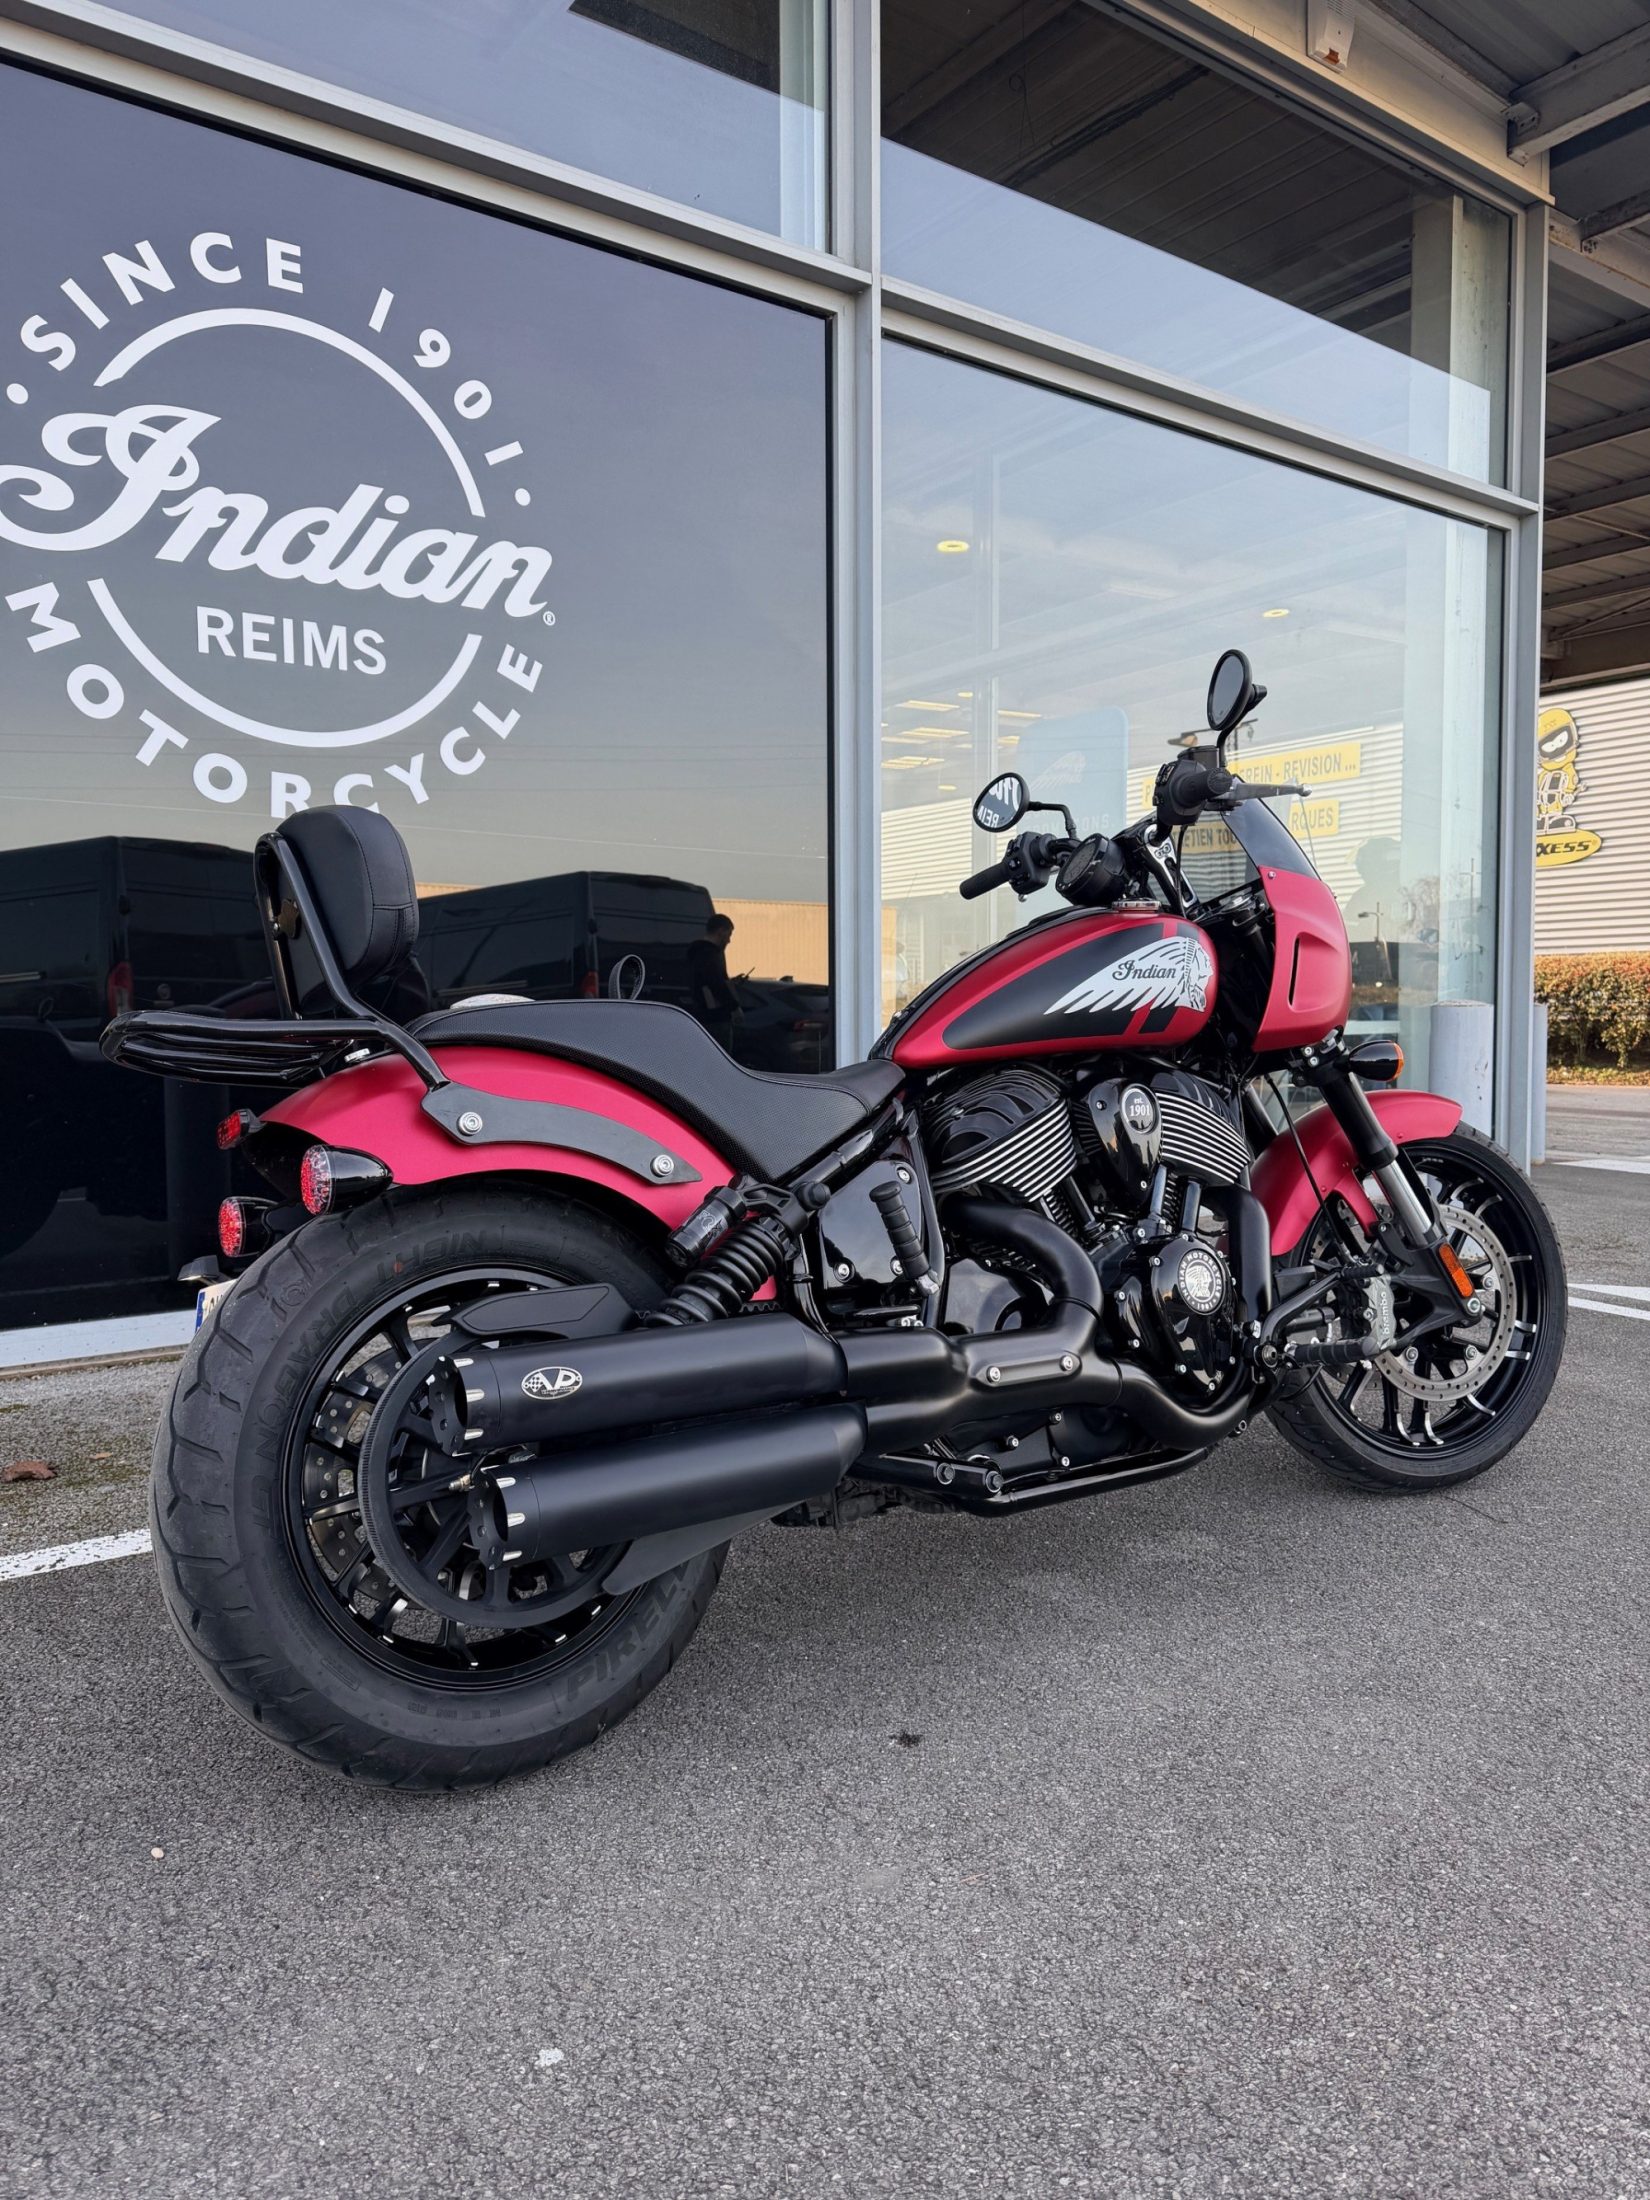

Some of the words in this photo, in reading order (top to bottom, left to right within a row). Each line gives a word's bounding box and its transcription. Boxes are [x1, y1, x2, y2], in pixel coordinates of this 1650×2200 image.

[20, 232, 304, 372] SINCE
[368, 287, 525, 467] 1901
[0, 404, 554, 618] Indian
[196, 605, 388, 676] REIMS
[5, 581, 544, 819] MOTORCYCLE
[1283, 752, 1342, 779] REVISION
[1291, 807, 1333, 831] ROUES
[1536, 839, 1592, 857] XESS
[1112, 959, 1177, 981] Indian
[1129, 1104, 1151, 1117] 1901
[1178, 1261, 1191, 1302] INDIAN
[1186, 1251, 1222, 1298] MOTORCYCLE
[1380, 1291, 1391, 1335] brembo
